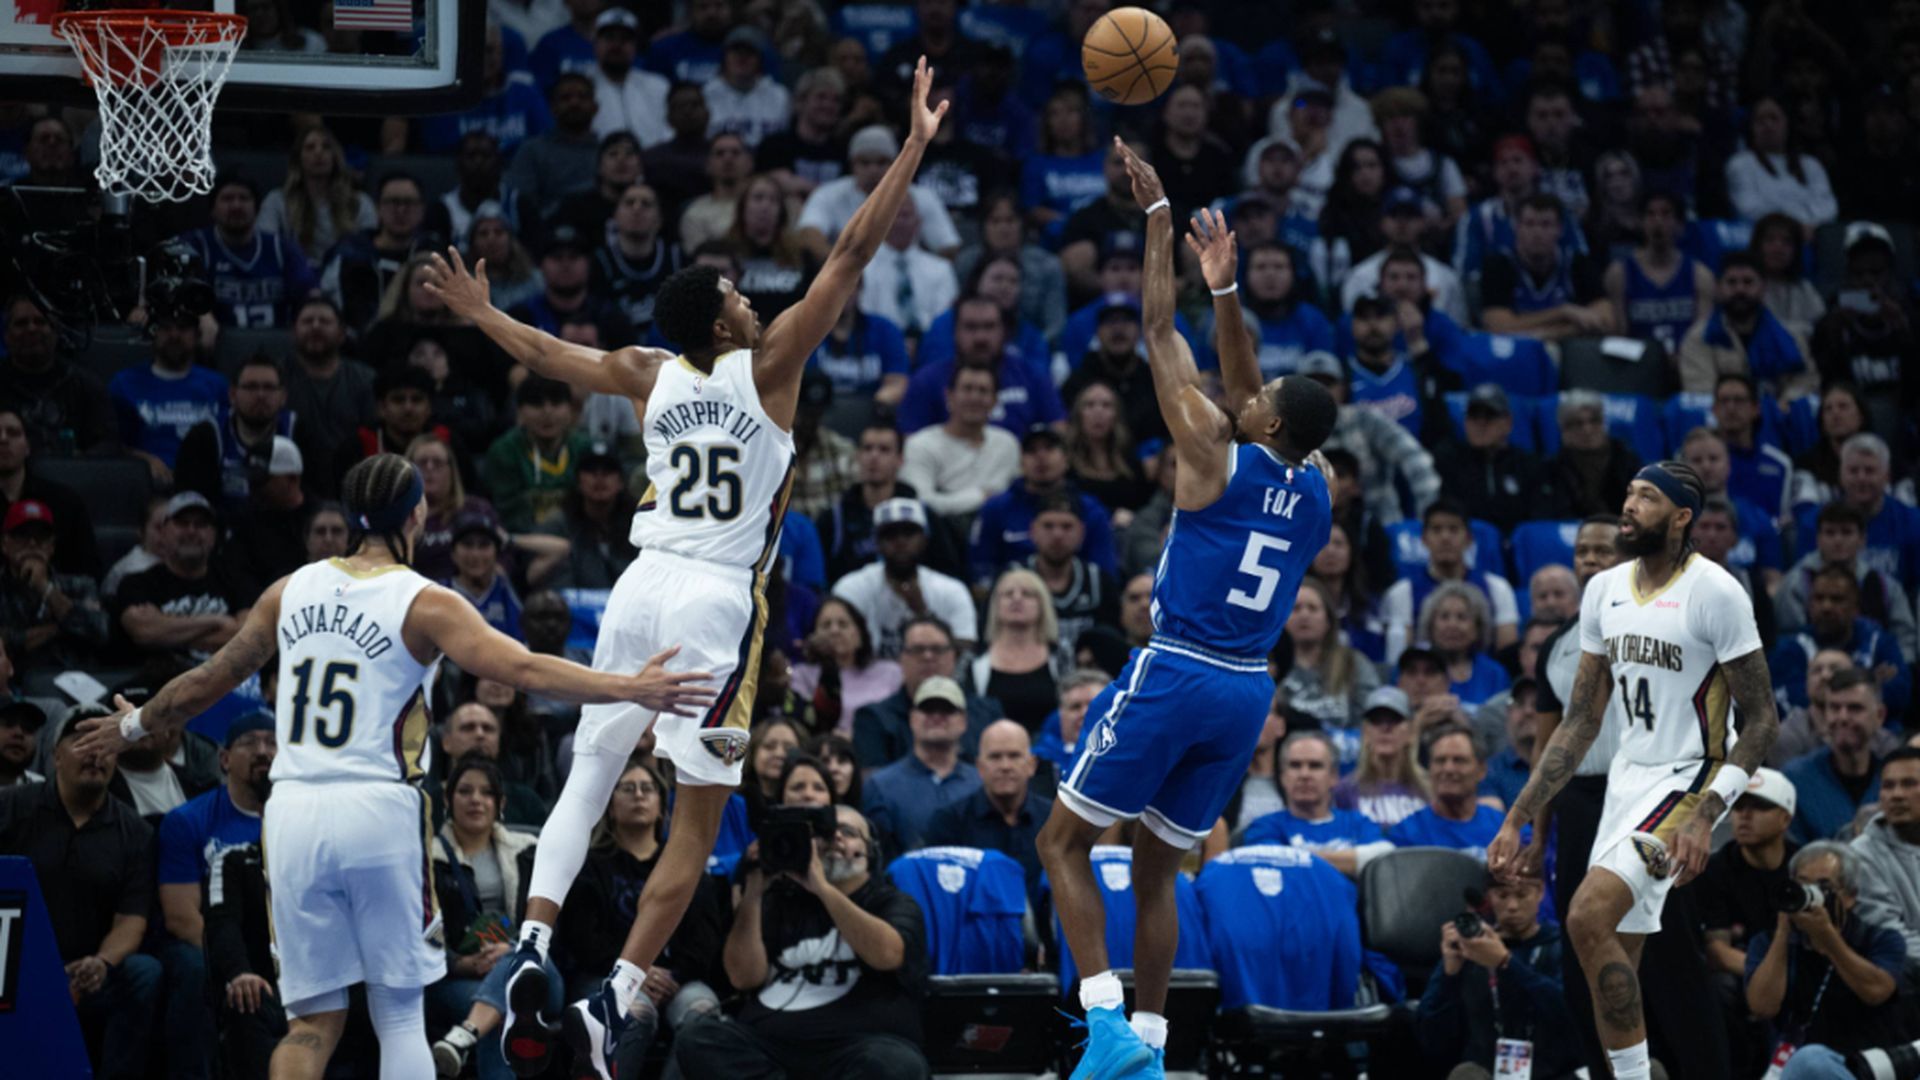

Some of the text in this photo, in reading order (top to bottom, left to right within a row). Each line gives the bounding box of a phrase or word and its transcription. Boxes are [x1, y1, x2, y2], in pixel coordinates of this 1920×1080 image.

[653, 400, 761, 445] MURPHY III
[670, 444, 743, 521] 25
[1262, 486, 1303, 520] FOX
[1225, 529, 1293, 613] 5
[281, 603, 393, 660] ALVARADO
[1621, 633, 1683, 672] ORLEANS
[288, 657, 358, 748] 15
[1618, 674, 1655, 732] 14
